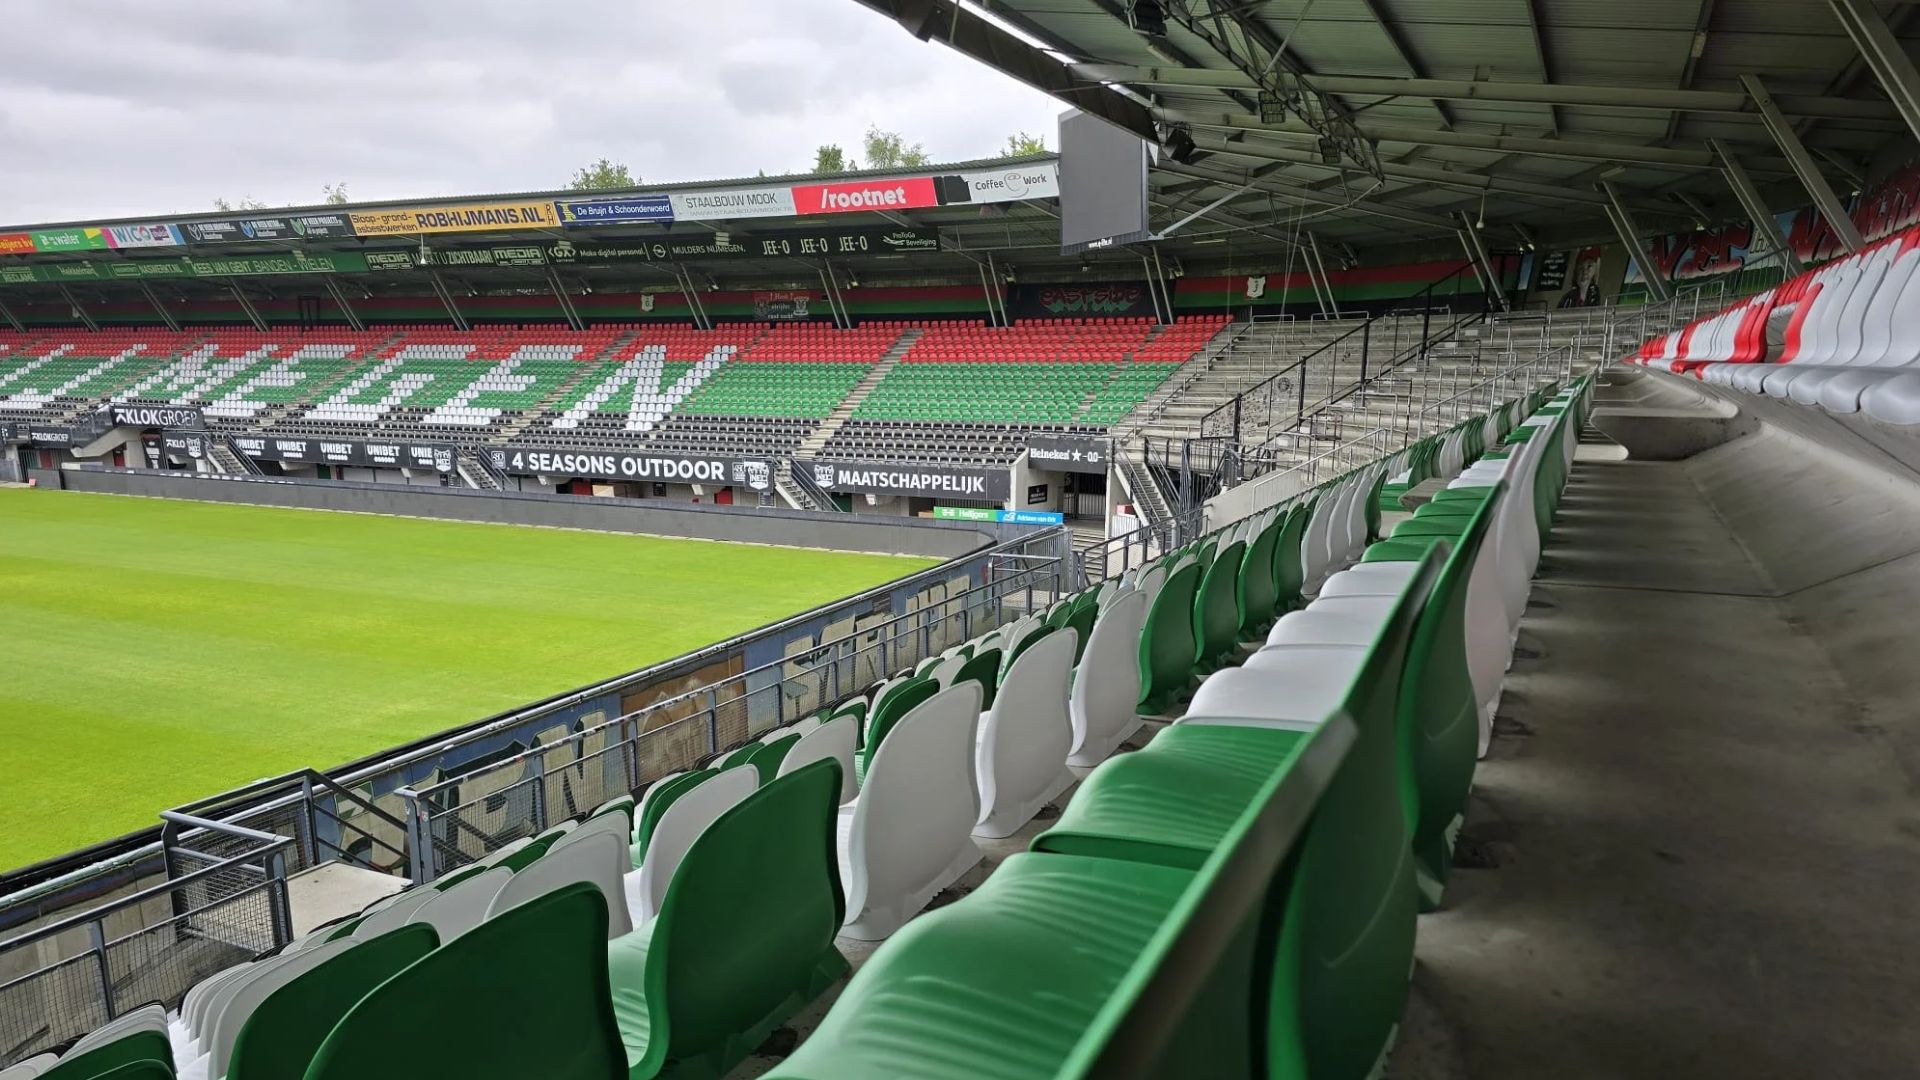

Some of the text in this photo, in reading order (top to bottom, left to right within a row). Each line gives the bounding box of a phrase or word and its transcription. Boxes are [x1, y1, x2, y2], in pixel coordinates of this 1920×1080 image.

[975, 180, 1004, 191] Coffee
[1023, 173, 1047, 185] Work
[685, 193, 778, 208] STAALBOUW MOOK
[821, 186, 907, 209] /rootnet
[577, 204, 670, 216] De Bruijn & Schoonderwoerd
[415, 207, 545, 228] ROBHIJMANS.NL
[357, 223, 418, 233] asbestwerken
[672, 246, 706, 254] MULDERS
[762, 240, 790, 255] JEE-O
[800, 238, 829, 253] JEE-O
[839, 235, 868, 252] JEE-O
[367, 253, 410, 263] MEDIA
[494, 248, 541, 259] MEDIA
[212, 261, 230, 273] VAN
[252, 259, 293, 272] BANDEN
[124, 408, 197, 427] KLOKGROEP
[276, 440, 307, 452] UNIBET
[320, 442, 352, 454] UNIBET
[366, 445, 400, 457] UNIBET
[1030, 448, 1070, 460] Heineken
[512, 452, 524, 470] 4
[528, 453, 617, 474] SEASONS
[621, 457, 725, 481] OUTDOOR
[838, 470, 985, 494] MAATSCHAPPELIJK
